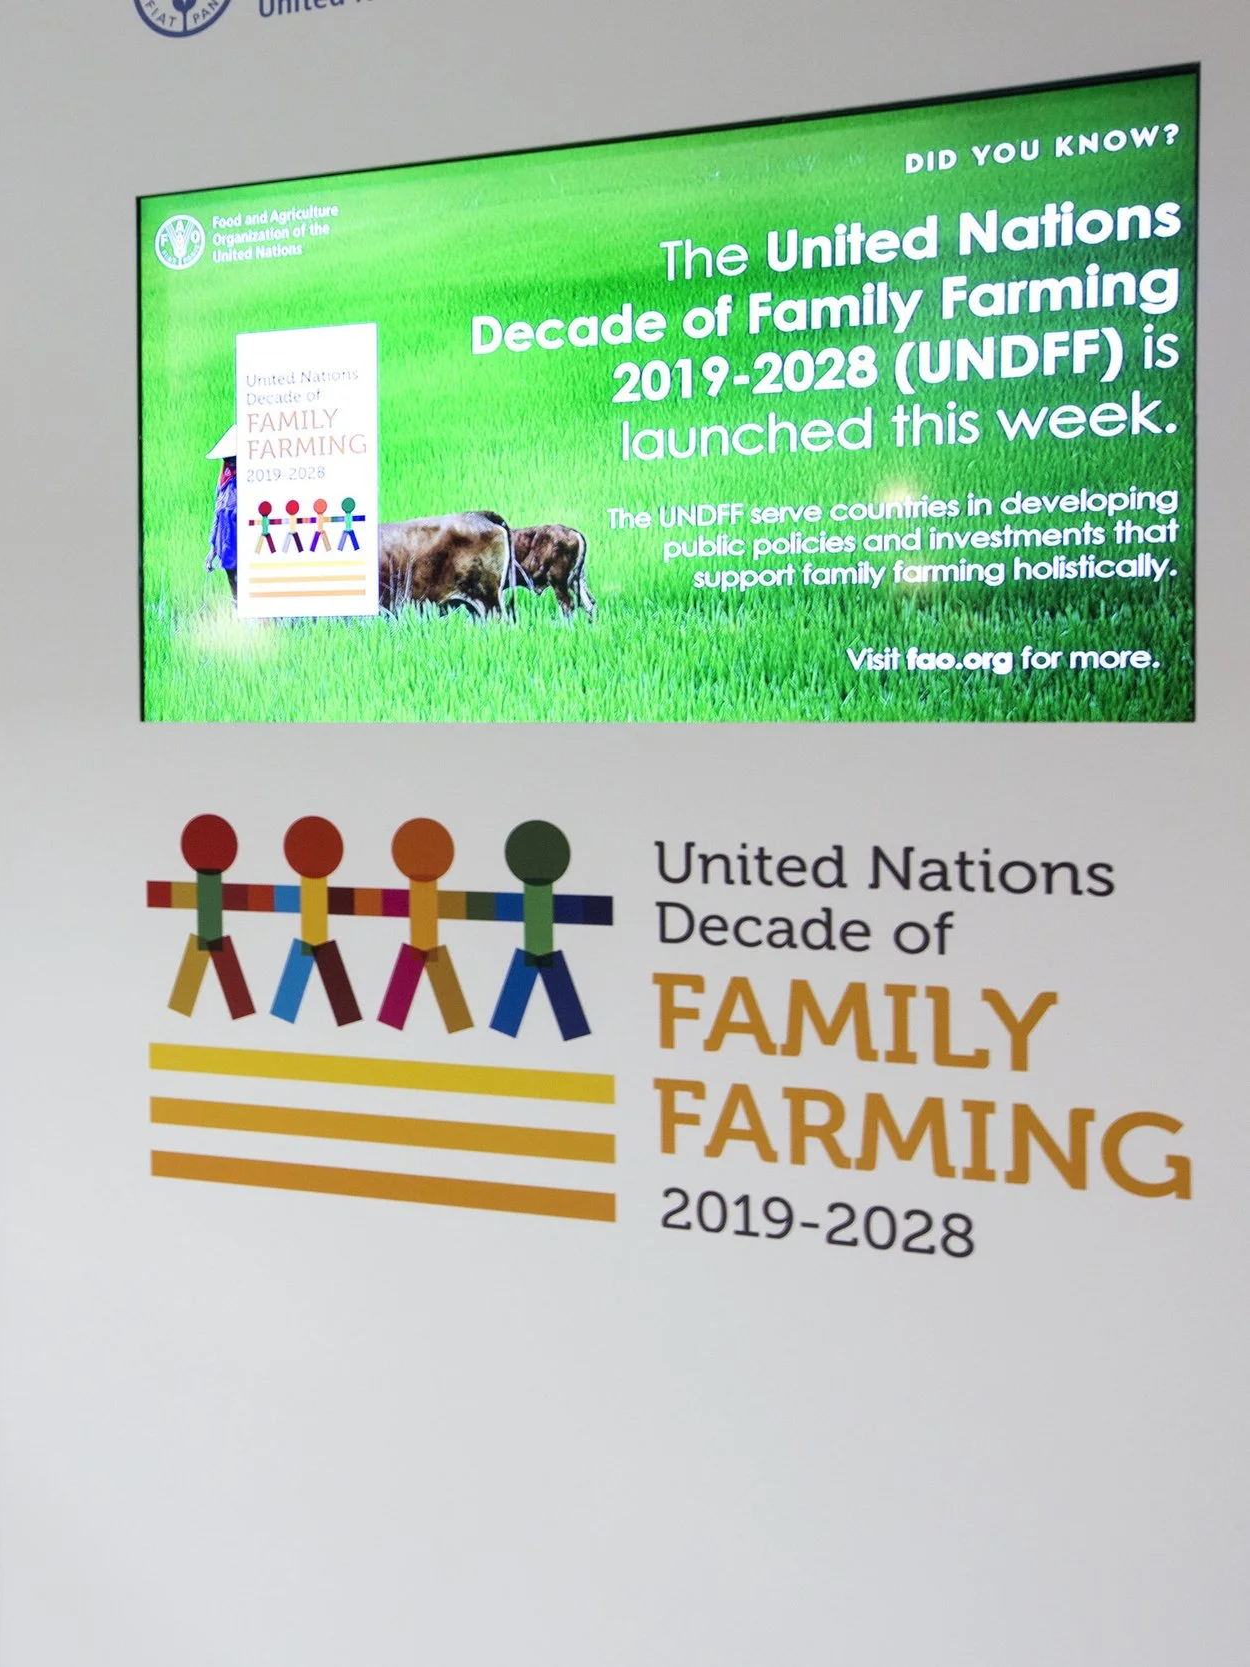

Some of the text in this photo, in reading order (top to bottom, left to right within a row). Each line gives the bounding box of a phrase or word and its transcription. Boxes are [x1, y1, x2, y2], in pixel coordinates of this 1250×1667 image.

[906, 124, 1178, 173] DID YOU KNOW?
[213, 205, 339, 228] Food and Agriculture
[213, 222, 330, 247] Organization of the
[213, 249, 253, 263] United
[256, 243, 302, 259] Nations
[661, 202, 1180, 280] The United Nations
[473, 264, 1178, 354] Decade of Family Farming
[246, 369, 359, 387] United Nations
[613, 324, 1178, 402] 2019-2028 (UNDFF) is
[246, 388, 320, 405] Decade of
[247, 408, 338, 433] FAMILY
[623, 391, 1176, 460] launched this week.
[247, 434, 367, 459] FARMING
[246, 466, 326, 482] 2019-2028
[607, 487, 1177, 529] The UNDFF serve countries in developing
[664, 518, 1178, 562] public policies and investments that
[694, 553, 1176, 592] support family farming holistically.
[847, 646, 1159, 674] Visit fao.org for more.
[655, 841, 1114, 896] United Nations
[656, 902, 953, 955] Decade of
[654, 973, 1057, 1071] FAMILY
[654, 1078, 1191, 1200] FARMING
[663, 1188, 973, 1257] 2019-2028
